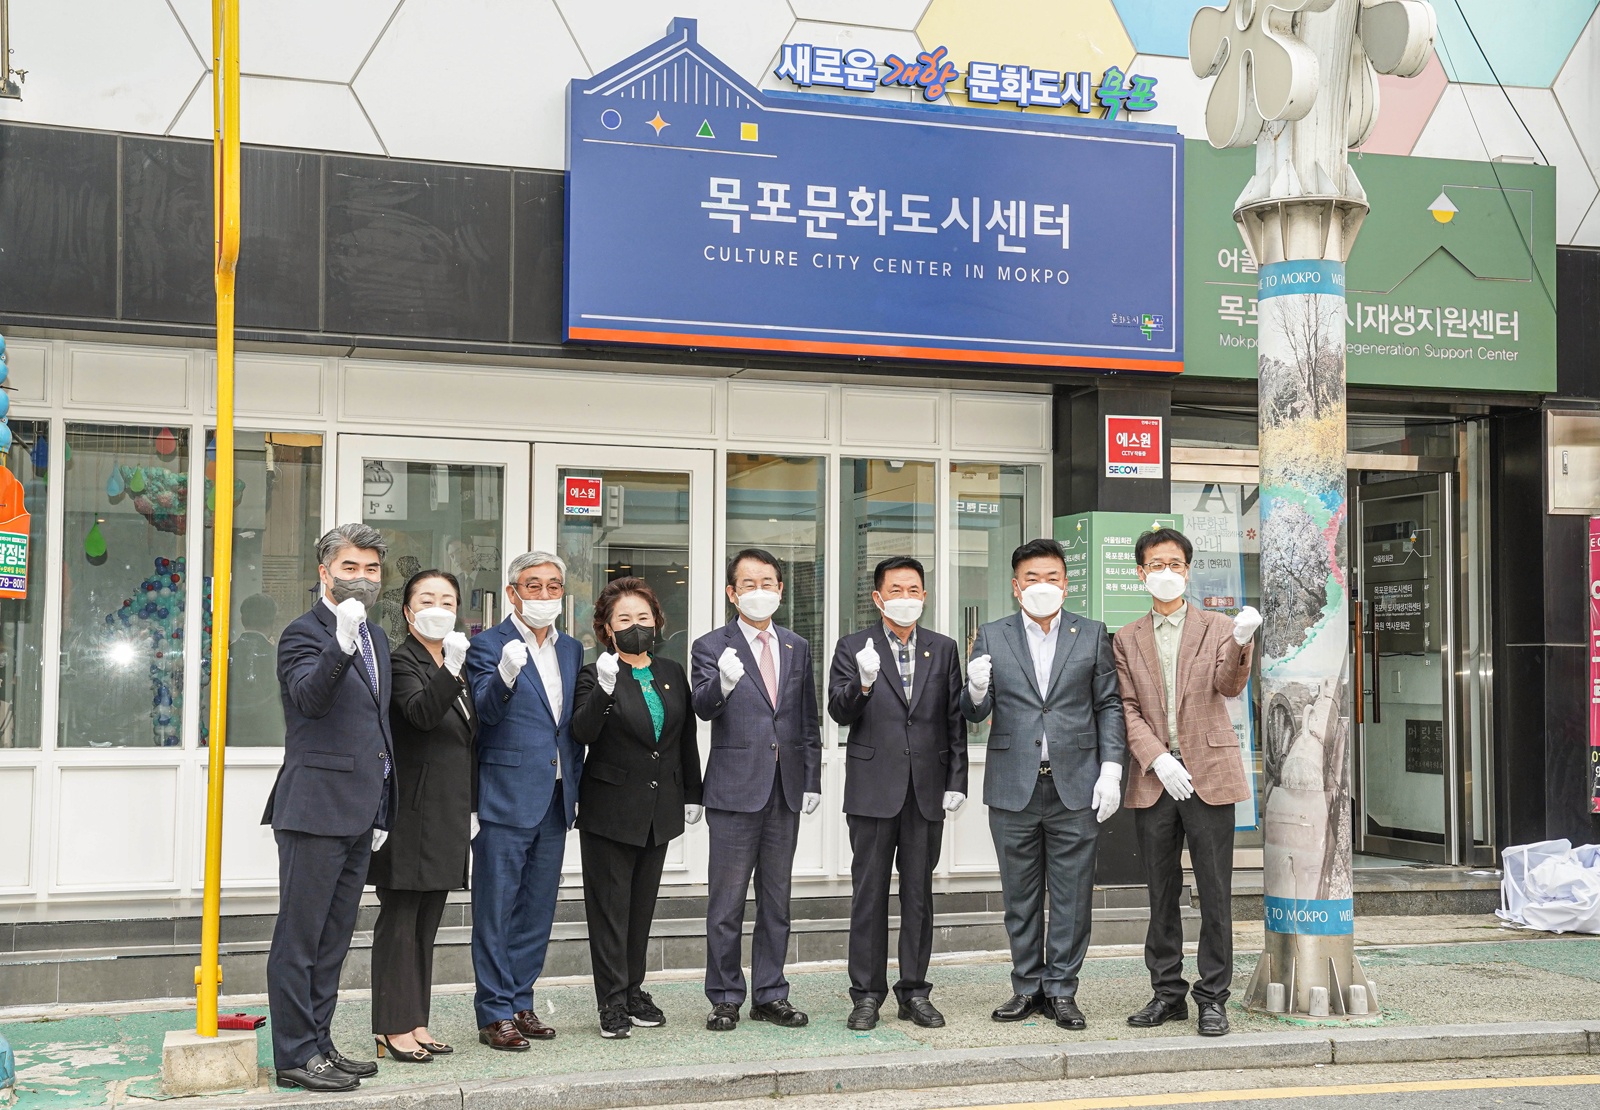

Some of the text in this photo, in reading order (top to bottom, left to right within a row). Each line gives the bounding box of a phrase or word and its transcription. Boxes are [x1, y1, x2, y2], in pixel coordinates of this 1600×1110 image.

[776, 44, 1158, 120] 새로운 개항 문화도시 목포
[701, 176, 1071, 254] 목포문화도시센터
[703, 245, 1070, 285] CULTURE CITY CENTER IN MOKPO
[1266, 275, 1277, 288] TO
[1281, 271, 1321, 285] MOKPO
[1424, 343, 1473, 359] Support
[1477, 346, 1518, 361] Center
[1116, 432, 1151, 448] 에스원
[1108, 465, 1138, 475] SECOM
[570, 487, 596, 499] 에스원
[566, 506, 590, 514] SECOM
[1103, 536, 1132, 545] 어울림회관
[1195, 534, 1222, 553] 안내
[1374, 584, 1413, 595] 목포문화도시센터
[1272, 908, 1283, 920] TO
[1286, 909, 1329, 923] MOKPO
